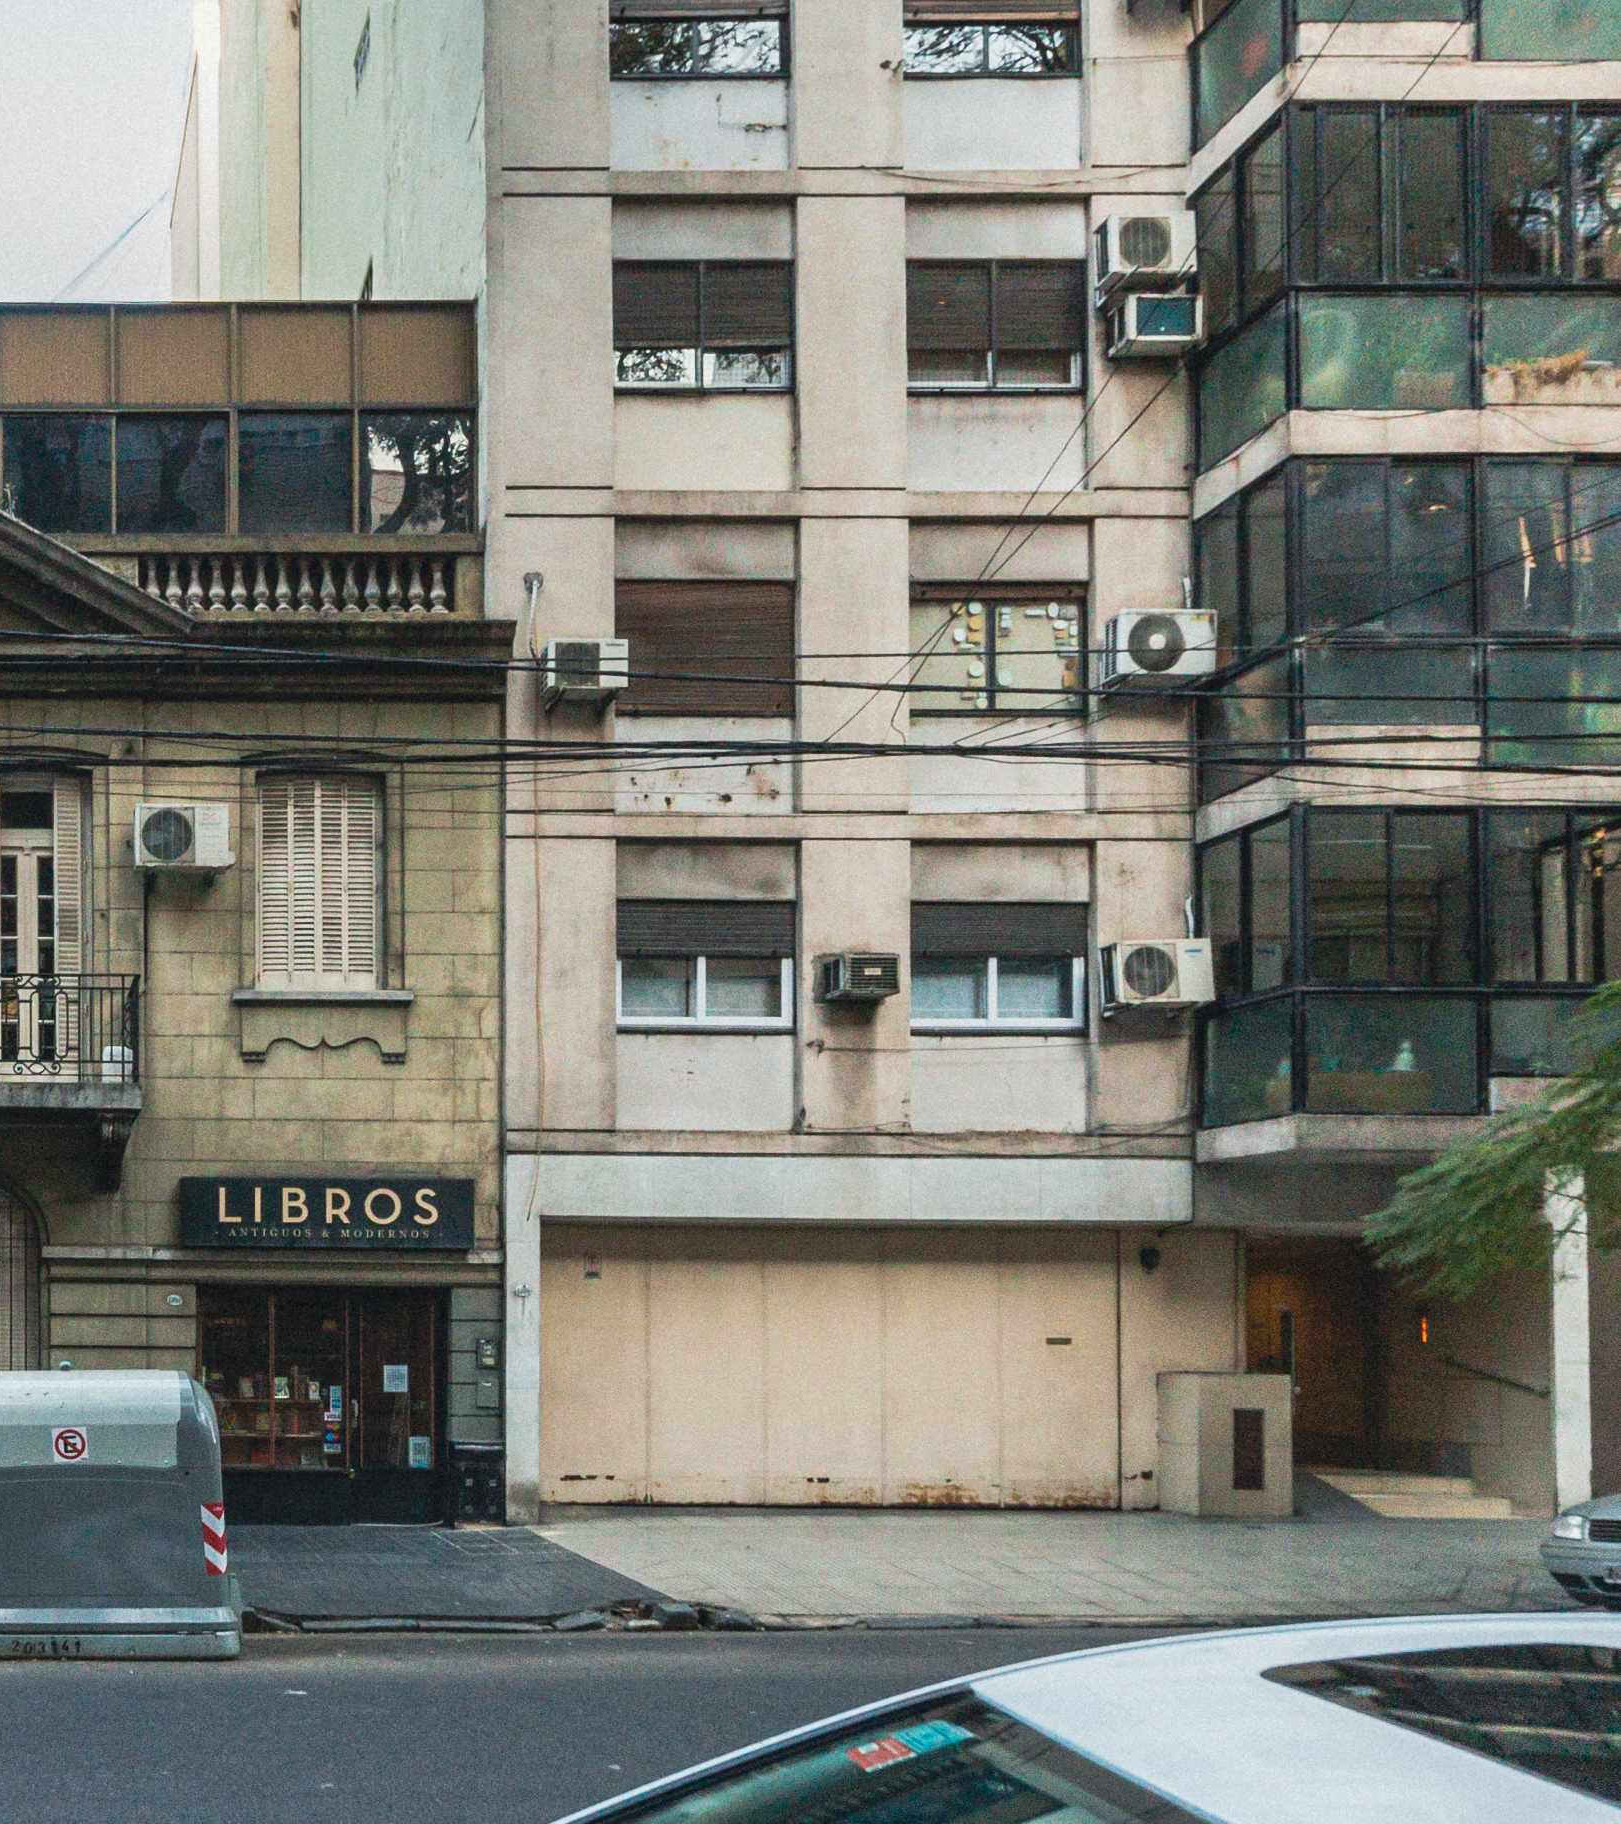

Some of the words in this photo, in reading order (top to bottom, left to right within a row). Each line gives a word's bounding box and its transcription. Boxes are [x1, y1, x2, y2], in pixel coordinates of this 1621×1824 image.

[218, 1186, 439, 1225] LIBROS
[228, 1228, 312, 1238] ANTIGUOS
[322, 1229, 331, 1238] &
[340, 1229, 431, 1239] MODERNOS
